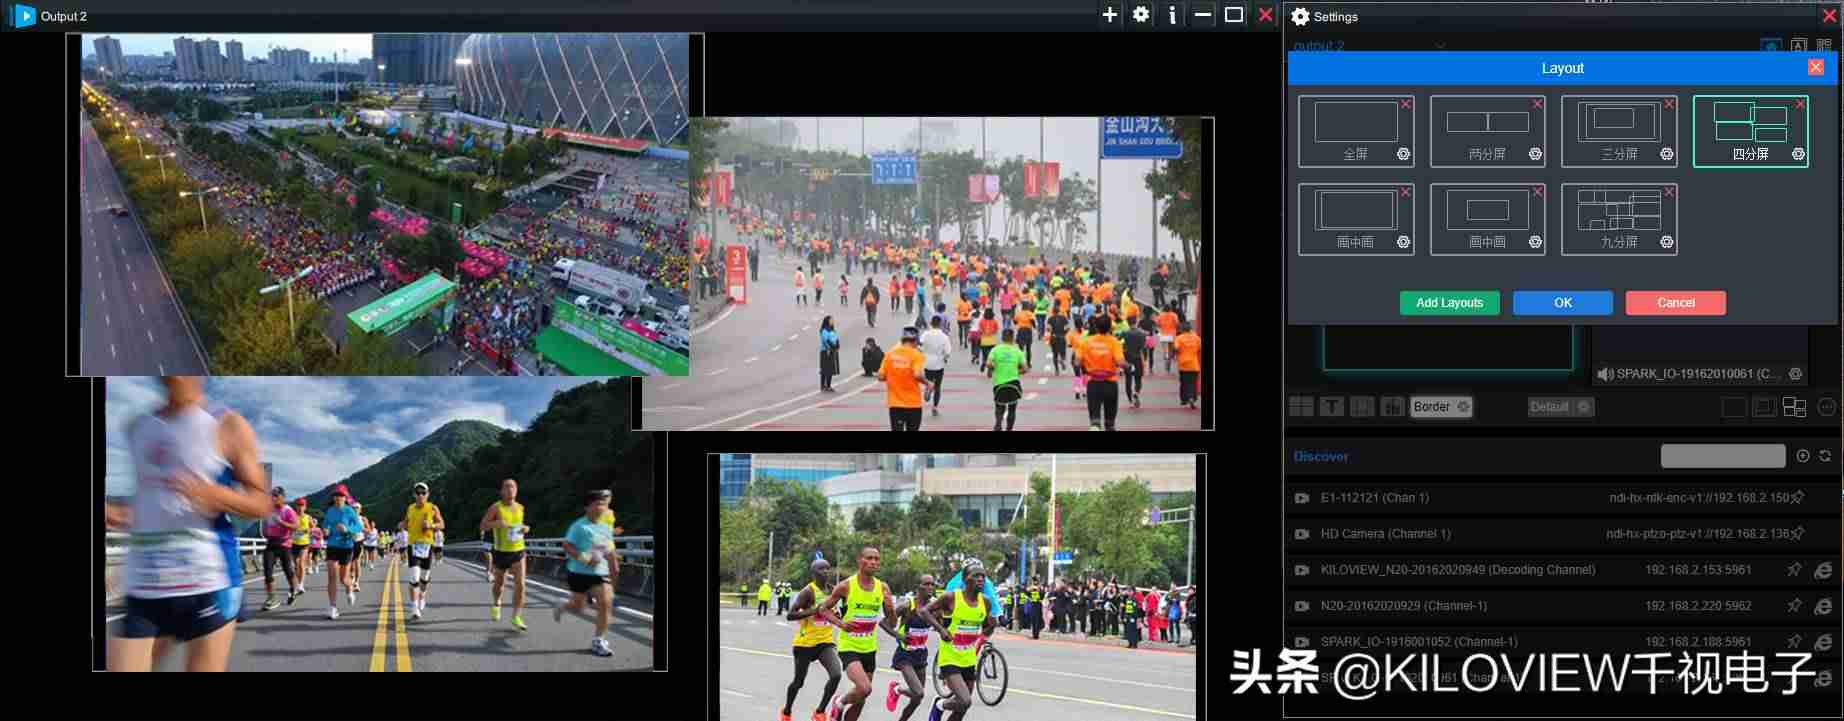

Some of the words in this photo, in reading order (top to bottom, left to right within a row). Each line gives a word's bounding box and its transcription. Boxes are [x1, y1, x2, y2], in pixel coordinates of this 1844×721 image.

[40, 11, 77, 23] Output
[80, 11, 88, 22] 2
[1314, 11, 1358, 24] Settings
[1542, 62, 1584, 77] Layout
[1343, 147, 1369, 161] 全屏
[1469, 147, 1506, 161] 两分屏
[1600, 147, 1638, 161] 三分屏
[1733, 147, 1769, 161] 四分屏
[1601, 235, 1639, 249] 九分屏
[1416, 296, 1437, 309] Add
[1441, 296, 1484, 311] Layouts
[1554, 296, 1573, 309] OK
[1656, 296, 1697, 309] Cancel
[1414, 399, 1450, 413] Border
[1294, 450, 1349, 463] Discover
[1320, 491, 1379, 504] E1-112121
[1382, 491, 1416, 505] (Chan
[1420, 491, 1430, 505] 1)
[1320, 527, 1339, 540] HD
[1341, 527, 1385, 540] Camera
[1388, 527, 1438, 541] (Channel
[1441, 527, 1452, 541] 1)
[1489, 563, 1543, 577] (Decoding
[1547, 563, 1597, 577] Channel)
[1320, 599, 1421, 613] N20-20162020929
[1423, 599, 1488, 614] (Channel-1)
[1455, 635, 1519, 649] (Channel-1)
